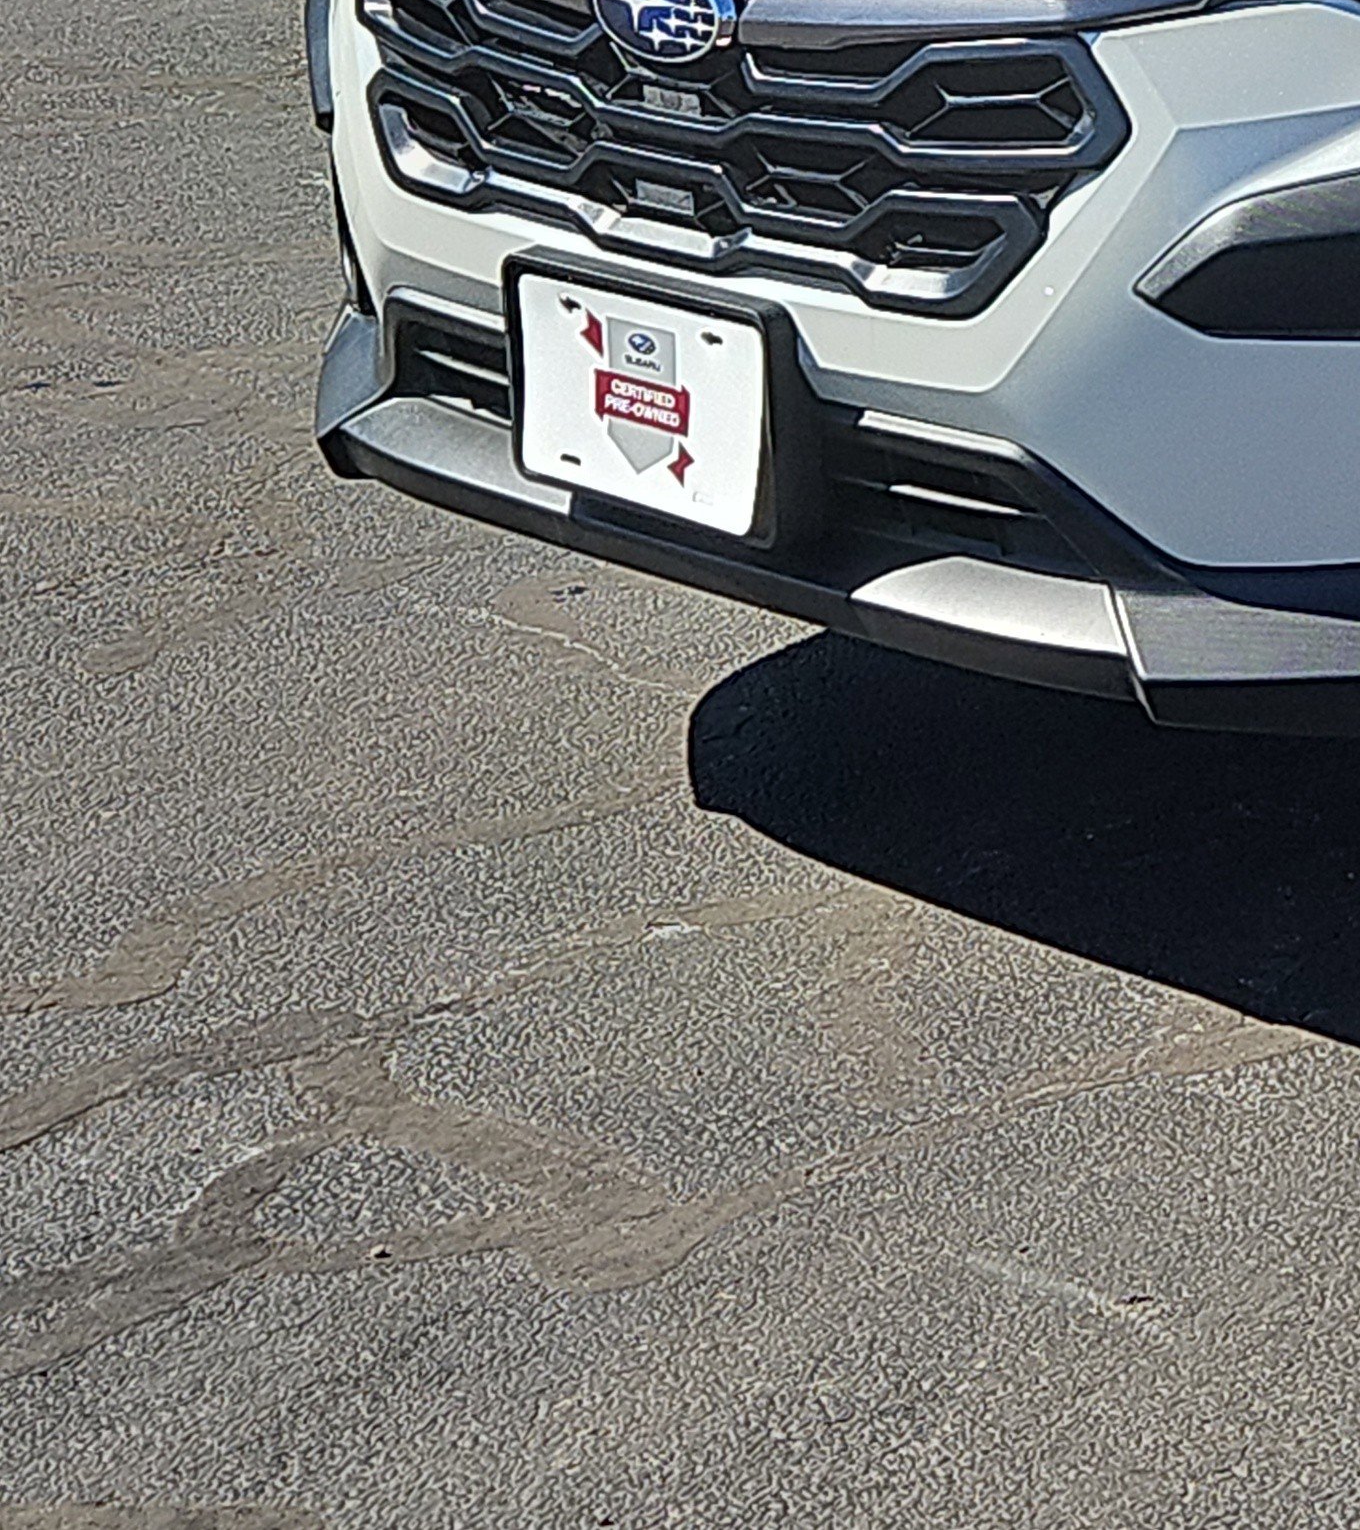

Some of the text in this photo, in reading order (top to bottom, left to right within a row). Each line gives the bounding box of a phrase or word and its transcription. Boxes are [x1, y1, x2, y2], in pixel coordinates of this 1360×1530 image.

[624, 354, 661, 372] SUBARU
[610, 378, 676, 409] CERTIFIED
[604, 393, 681, 427] PRE-OWNED
